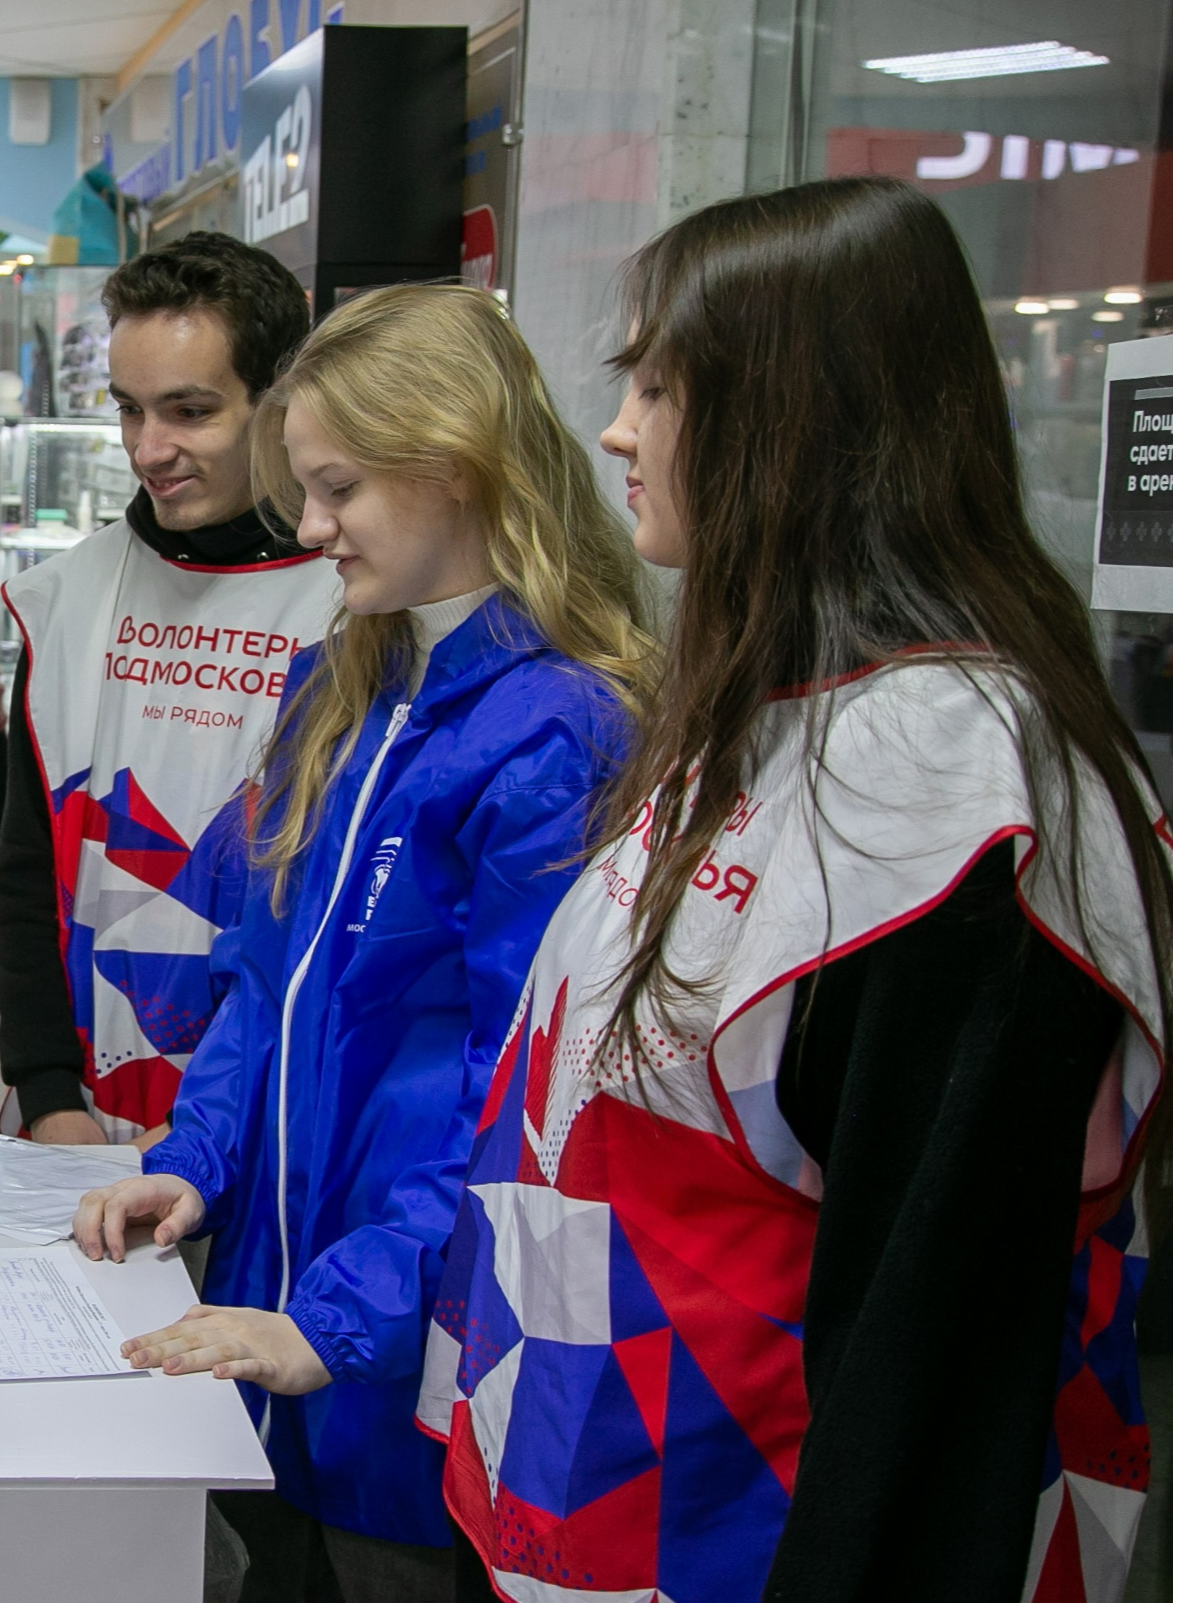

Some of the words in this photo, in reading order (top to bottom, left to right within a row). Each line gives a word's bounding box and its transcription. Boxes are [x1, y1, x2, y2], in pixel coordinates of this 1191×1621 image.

[174, 0, 343, 183] ГЛОБ
[244, 84, 312, 244] TELE2
[1128, 475, 1137, 492] в
[142, 704, 165, 720] МЫ
[170, 706, 243, 729] РЯДОМ
